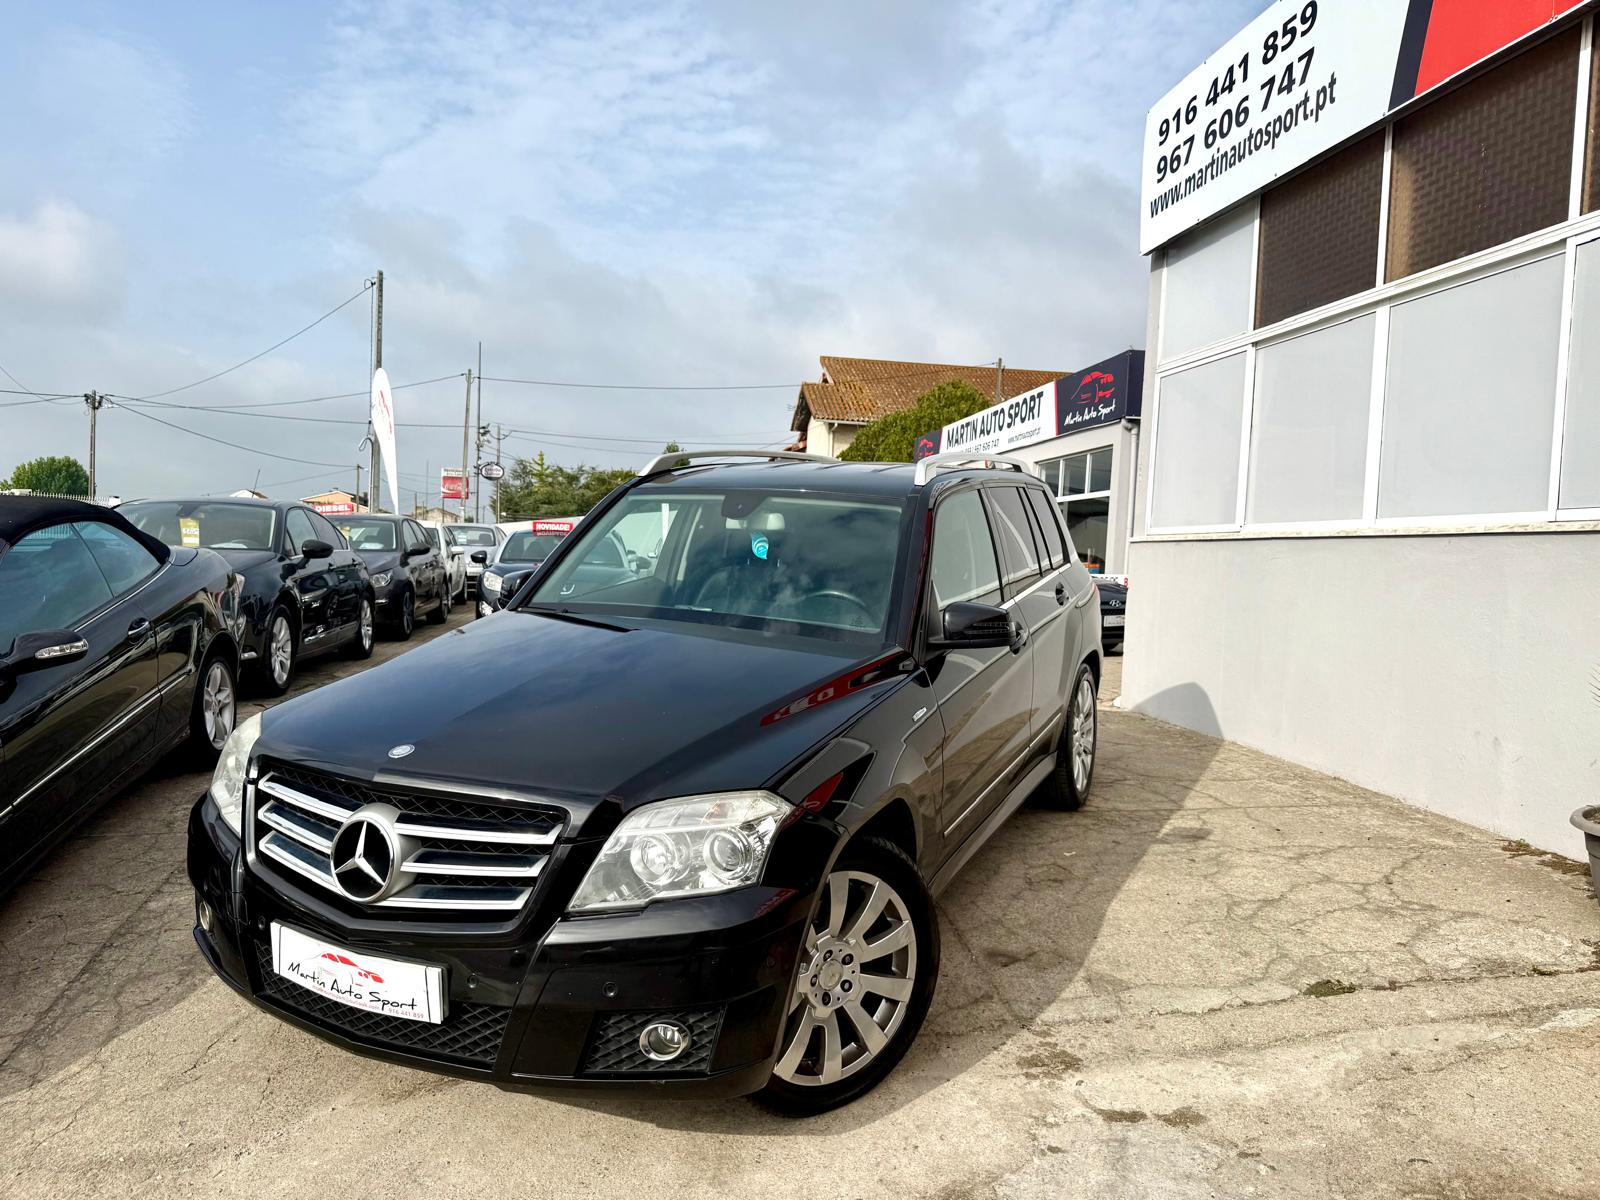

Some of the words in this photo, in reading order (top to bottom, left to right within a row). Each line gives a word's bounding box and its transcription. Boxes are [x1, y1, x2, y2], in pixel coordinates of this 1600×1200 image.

[1158, 95, 1198, 147] 916
[1205, 52, 1249, 107] 441
[1262, 0, 1318, 65] 859
[1156, 134, 1195, 184] 967
[1204, 95, 1250, 149] 606
[1260, 46, 1315, 113] 747
[1150, 71, 1337, 219] www.martinautosport.pt
[947, 418, 977, 449] MARTIN
[979, 406, 1005, 436] AUTO
[1007, 391, 1043, 428] SPORT
[1064, 412, 1083, 426] Martin
[1083, 406, 1097, 421] Auto
[1098, 398, 1116, 421] Sport
[535, 523, 571, 531] NOVIDADE!
[287, 962, 326, 988] Martin
[330, 978, 363, 1000] Auto
[369, 991, 417, 1011] Sport
